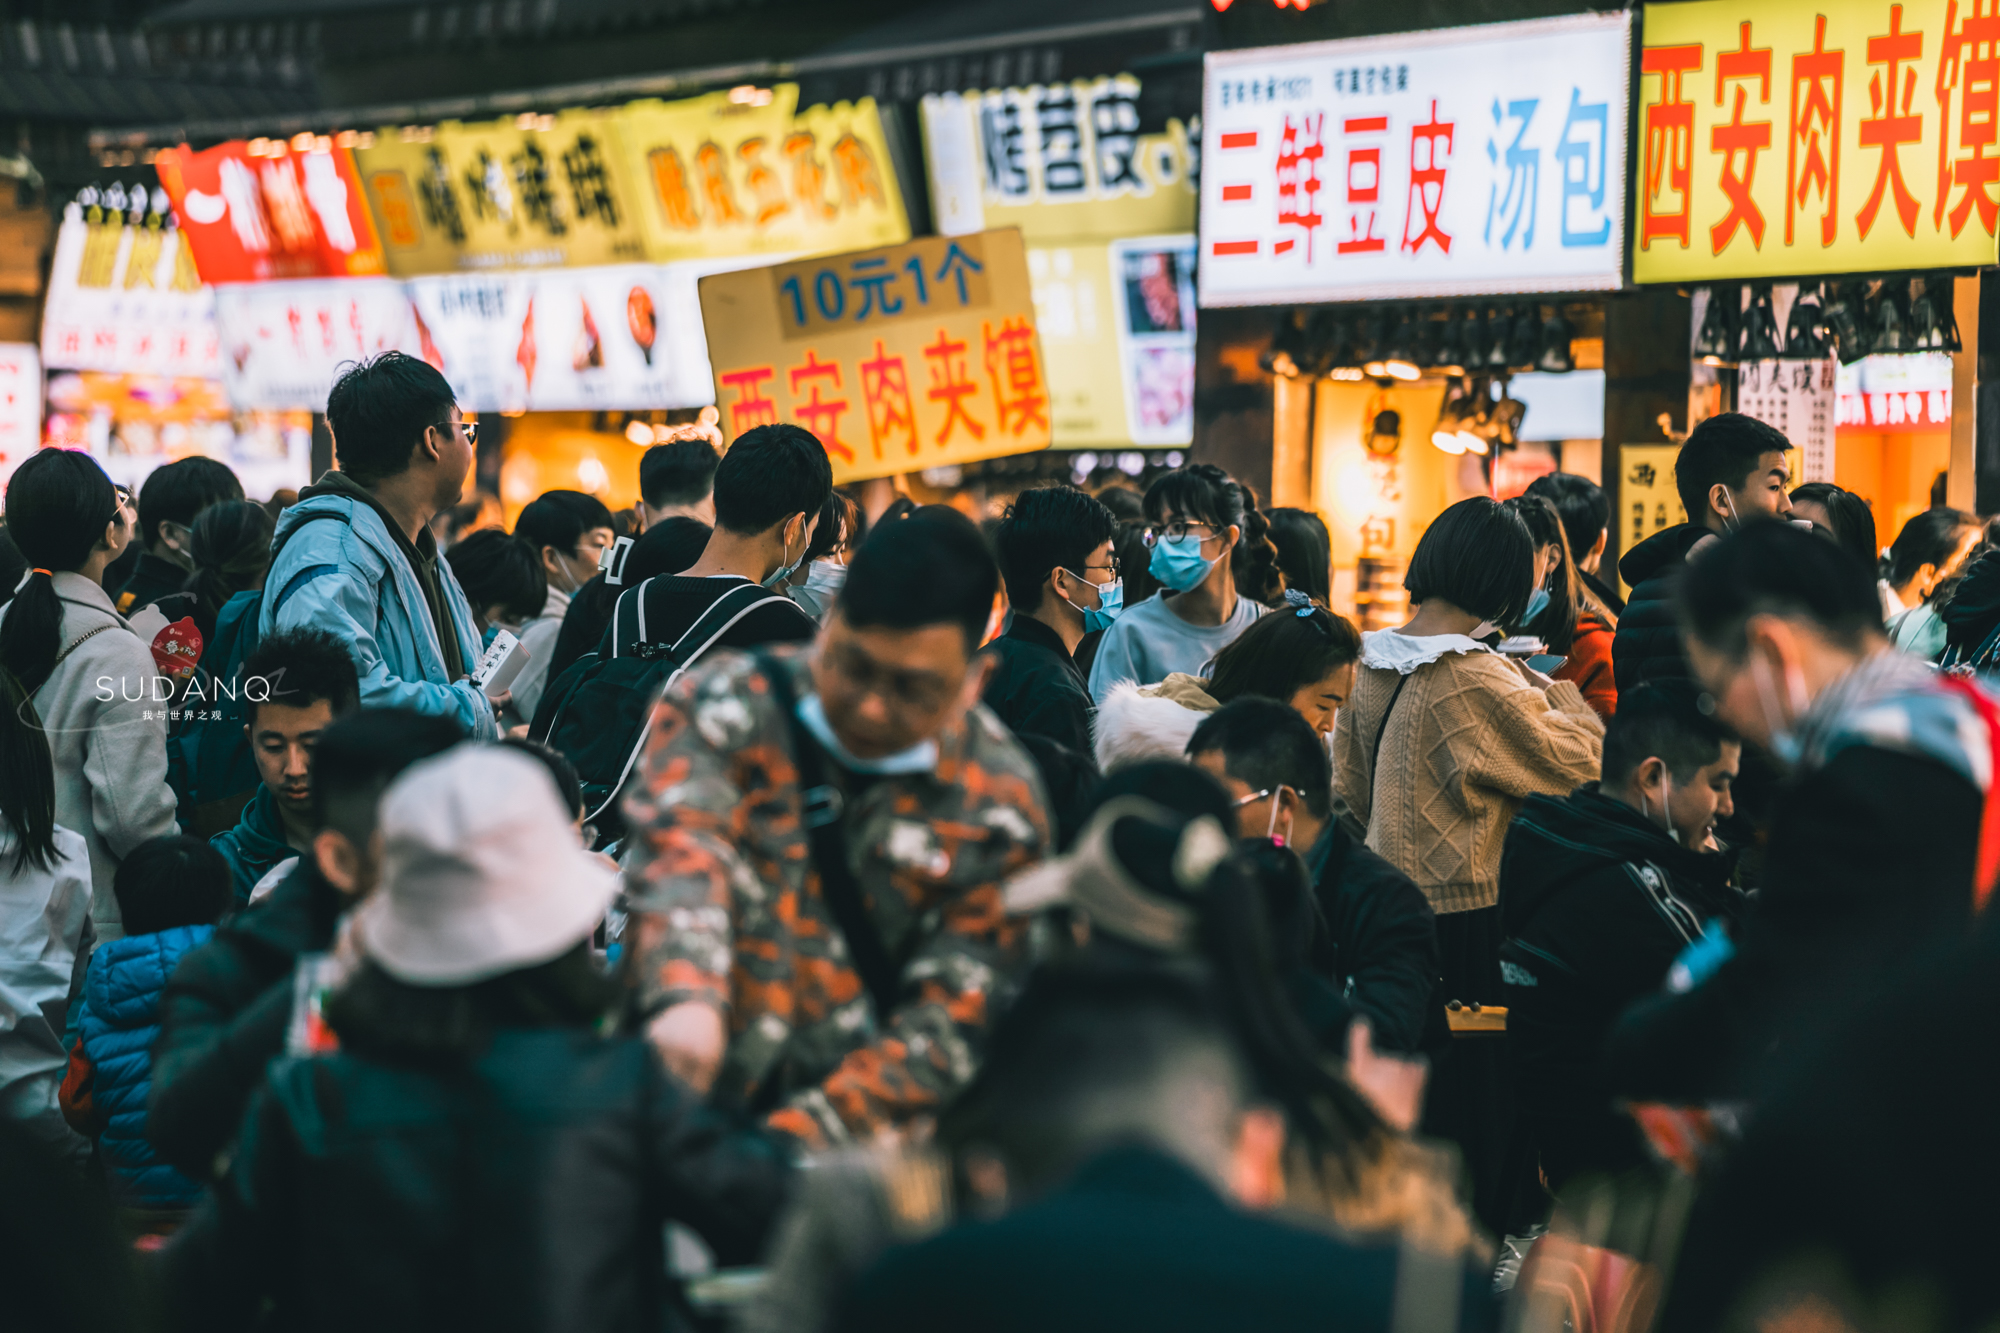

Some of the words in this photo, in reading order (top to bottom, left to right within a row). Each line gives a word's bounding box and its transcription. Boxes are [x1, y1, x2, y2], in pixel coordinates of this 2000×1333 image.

[1212, 96, 1456, 264] 三鲜豆皮
[1483, 85, 1611, 252] 汤包
[1641, 0, 2000, 256] 西安肉夹馍
[780, 240, 983, 328] 10元1个
[721, 316, 1050, 464] 西安肉夹馍
